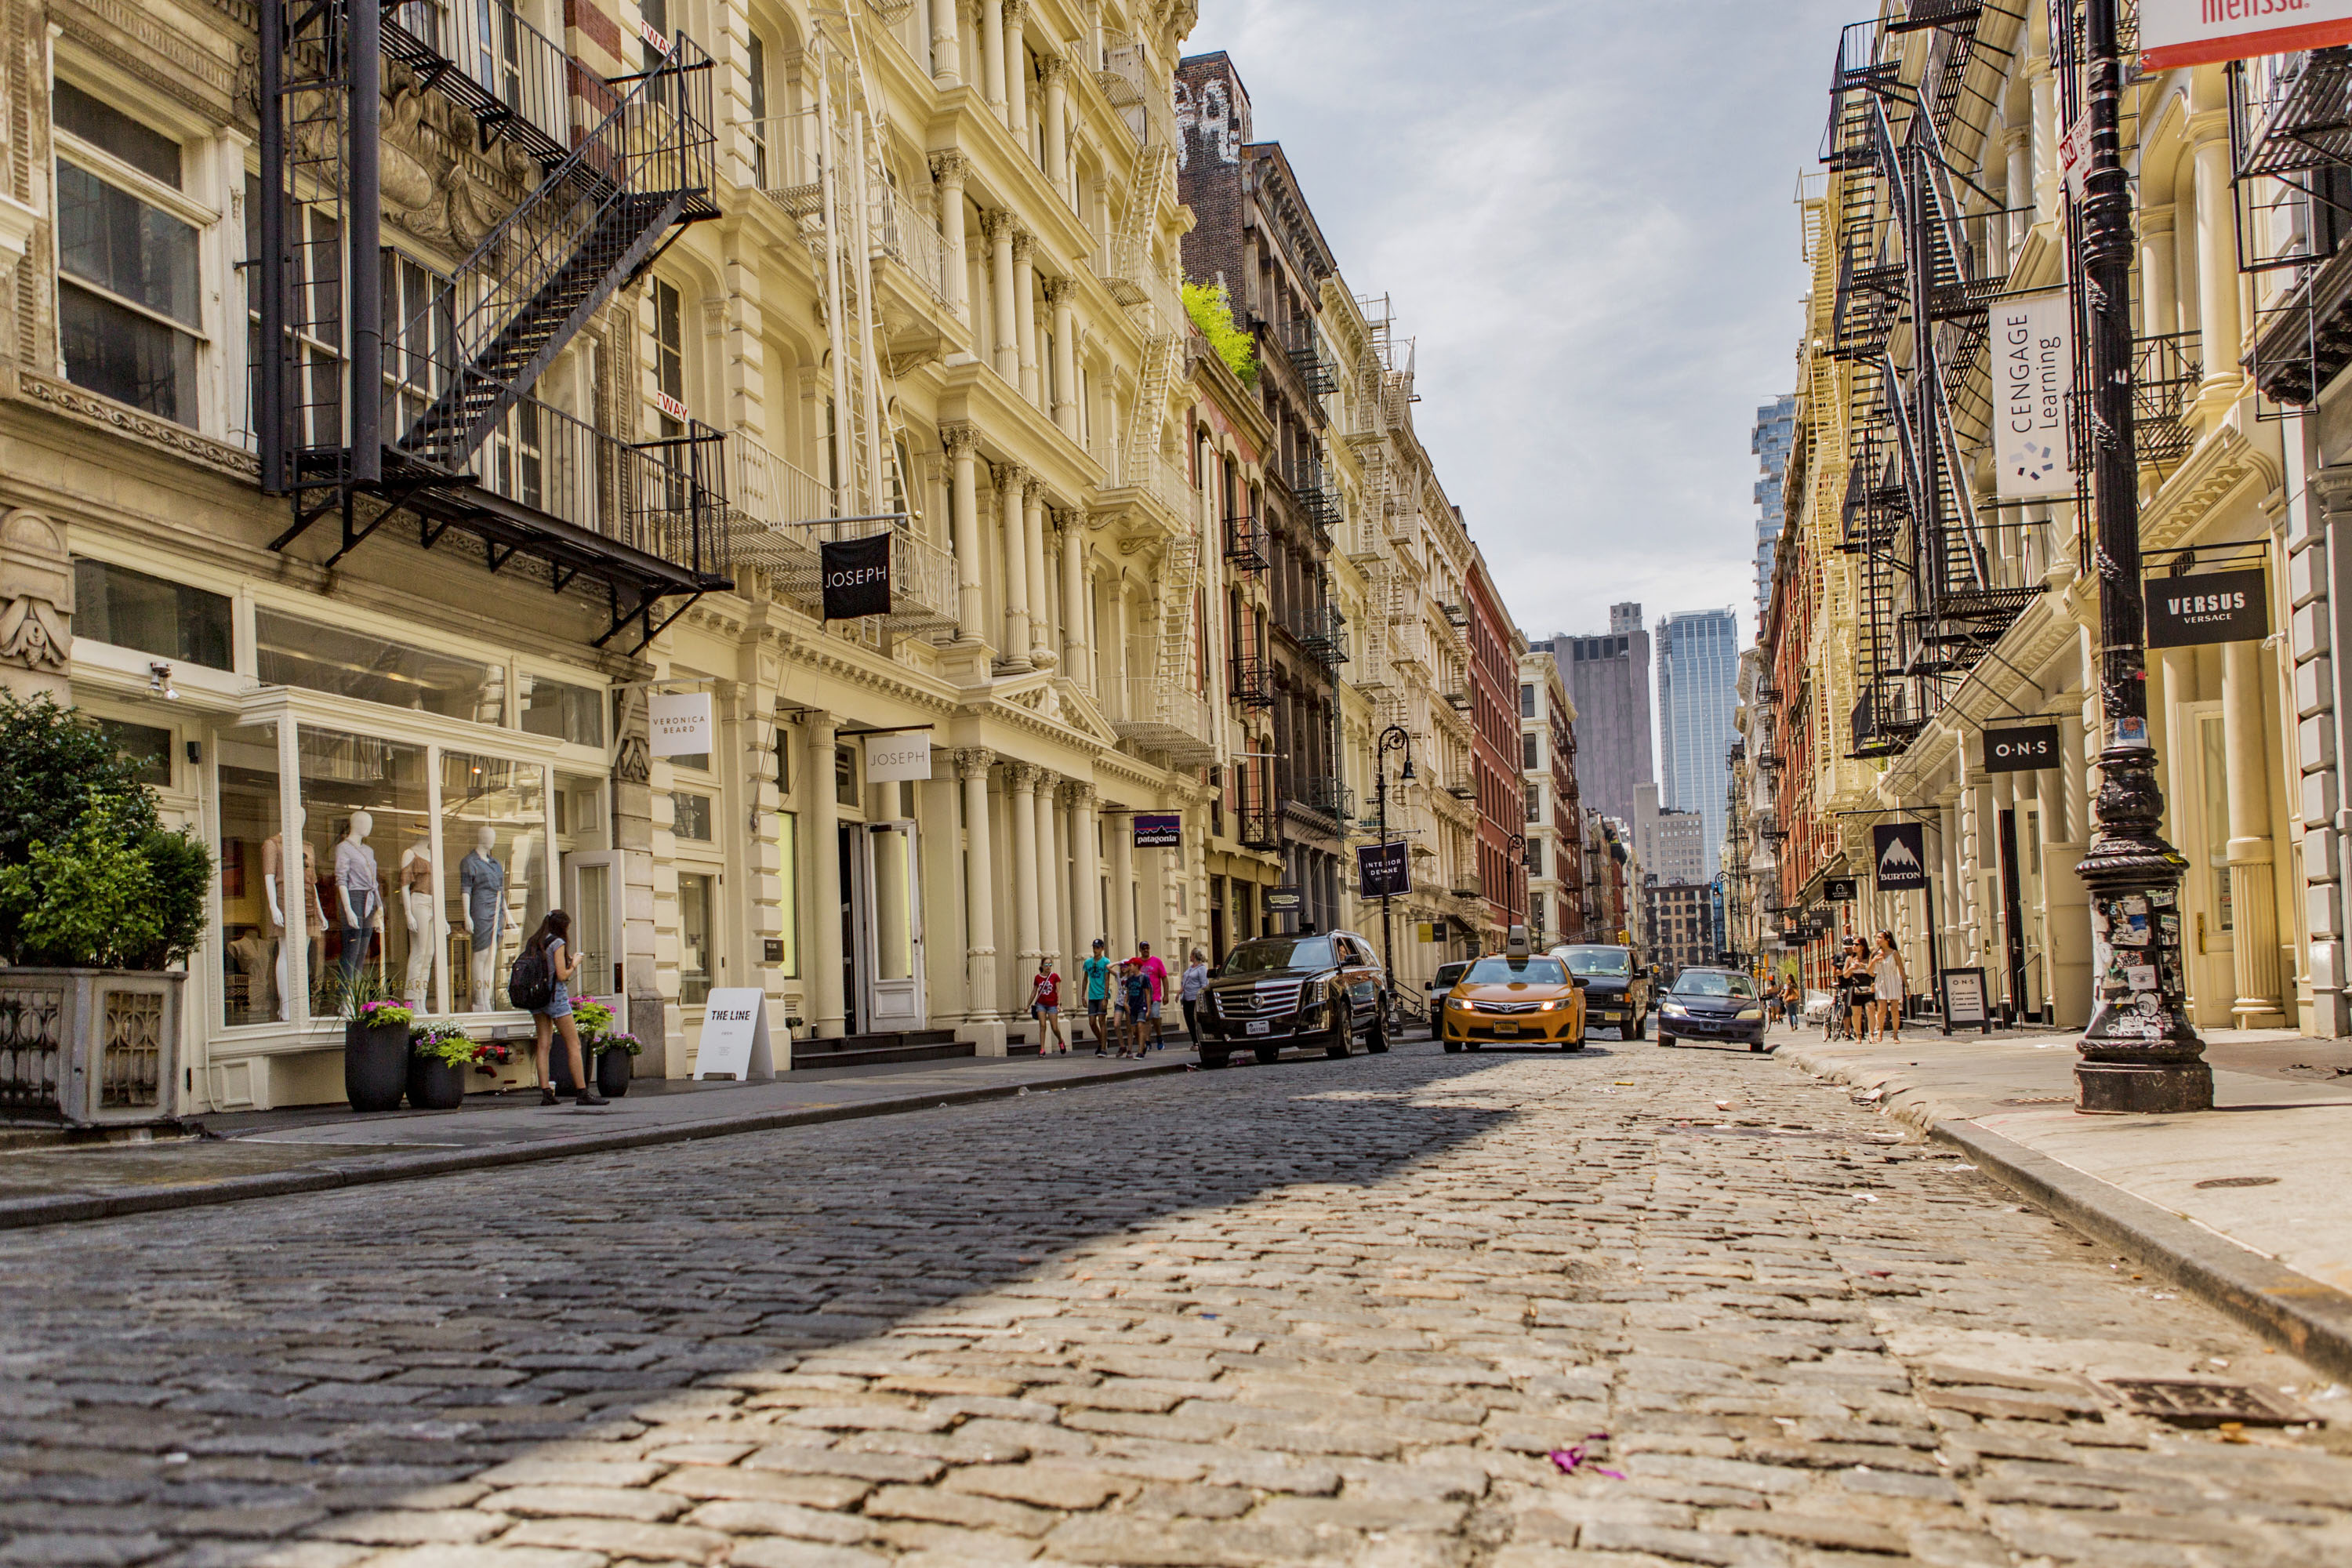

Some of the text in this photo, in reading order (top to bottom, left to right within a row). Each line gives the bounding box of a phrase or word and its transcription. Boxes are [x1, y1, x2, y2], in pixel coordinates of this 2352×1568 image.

[2060, 139, 2076, 167] NO
[2007, 314, 2032, 433] CENGAGE
[2036, 336, 2061, 429] Learning
[826, 565, 886, 589] JOSEPH
[2168, 592, 2246, 615] VERSUS
[2184, 613, 2232, 623] VERSACE
[653, 716, 705, 725] VERONICA
[663, 725, 695, 734] BEARD
[871, 752, 924, 767] JOSEPH
[1138, 834, 1177, 844] patagonia
[1366, 858, 1401, 869] INTEIOR
[1370, 867, 1398, 876] DENE
[1881, 872, 1920, 881] BURTON
[712, 1011, 750, 1020] THE LINE
